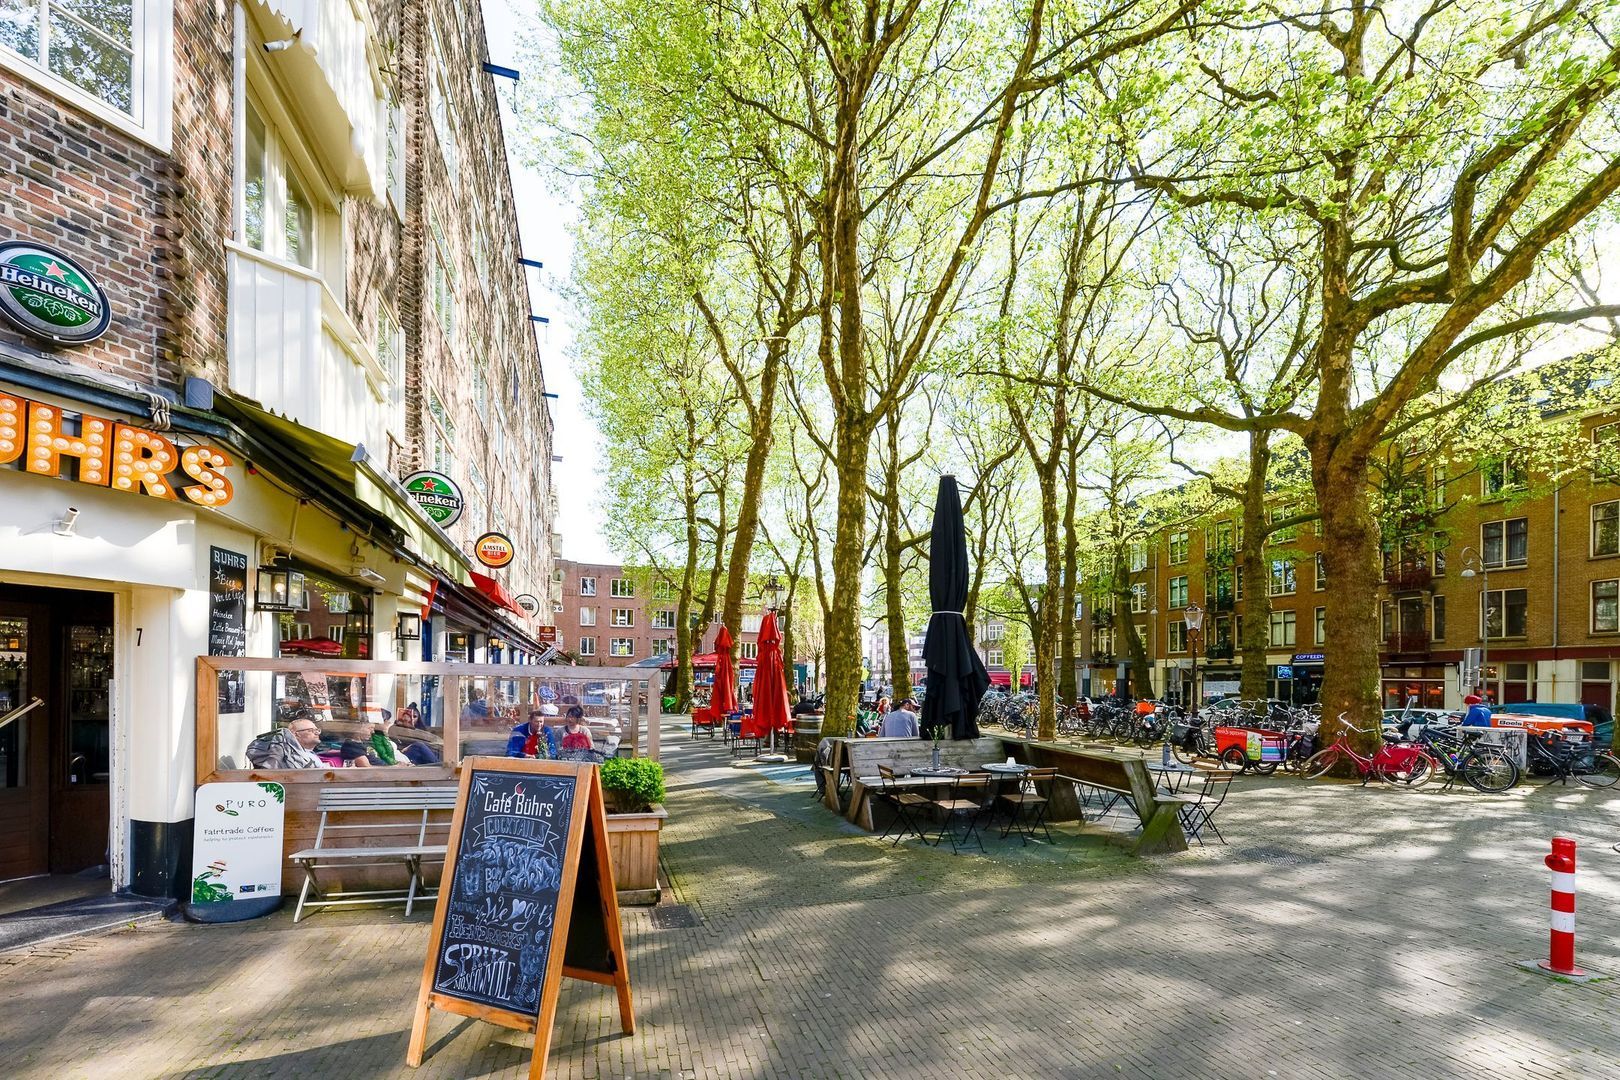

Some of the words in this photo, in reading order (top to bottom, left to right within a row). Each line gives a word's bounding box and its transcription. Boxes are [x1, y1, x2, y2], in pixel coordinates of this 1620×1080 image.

[1, 266, 98, 315] Heineken
[411, 492, 457, 508] eineken
[482, 544, 506, 552] AMSTEL
[214, 550, 246, 570] BUHRS
[136, 627, 143, 647] 7
[226, 799, 267, 809] PURO
[484, 791, 512, 813] Café
[515, 794, 554, 818] Bührs
[204, 827, 244, 835] Fairtrade
[247, 826, 275, 834] Coffee
[487, 818, 547, 842] COCKTAILS
[449, 914, 528, 950] HENDRICKS
[439, 943, 509, 988] SPRITZ
